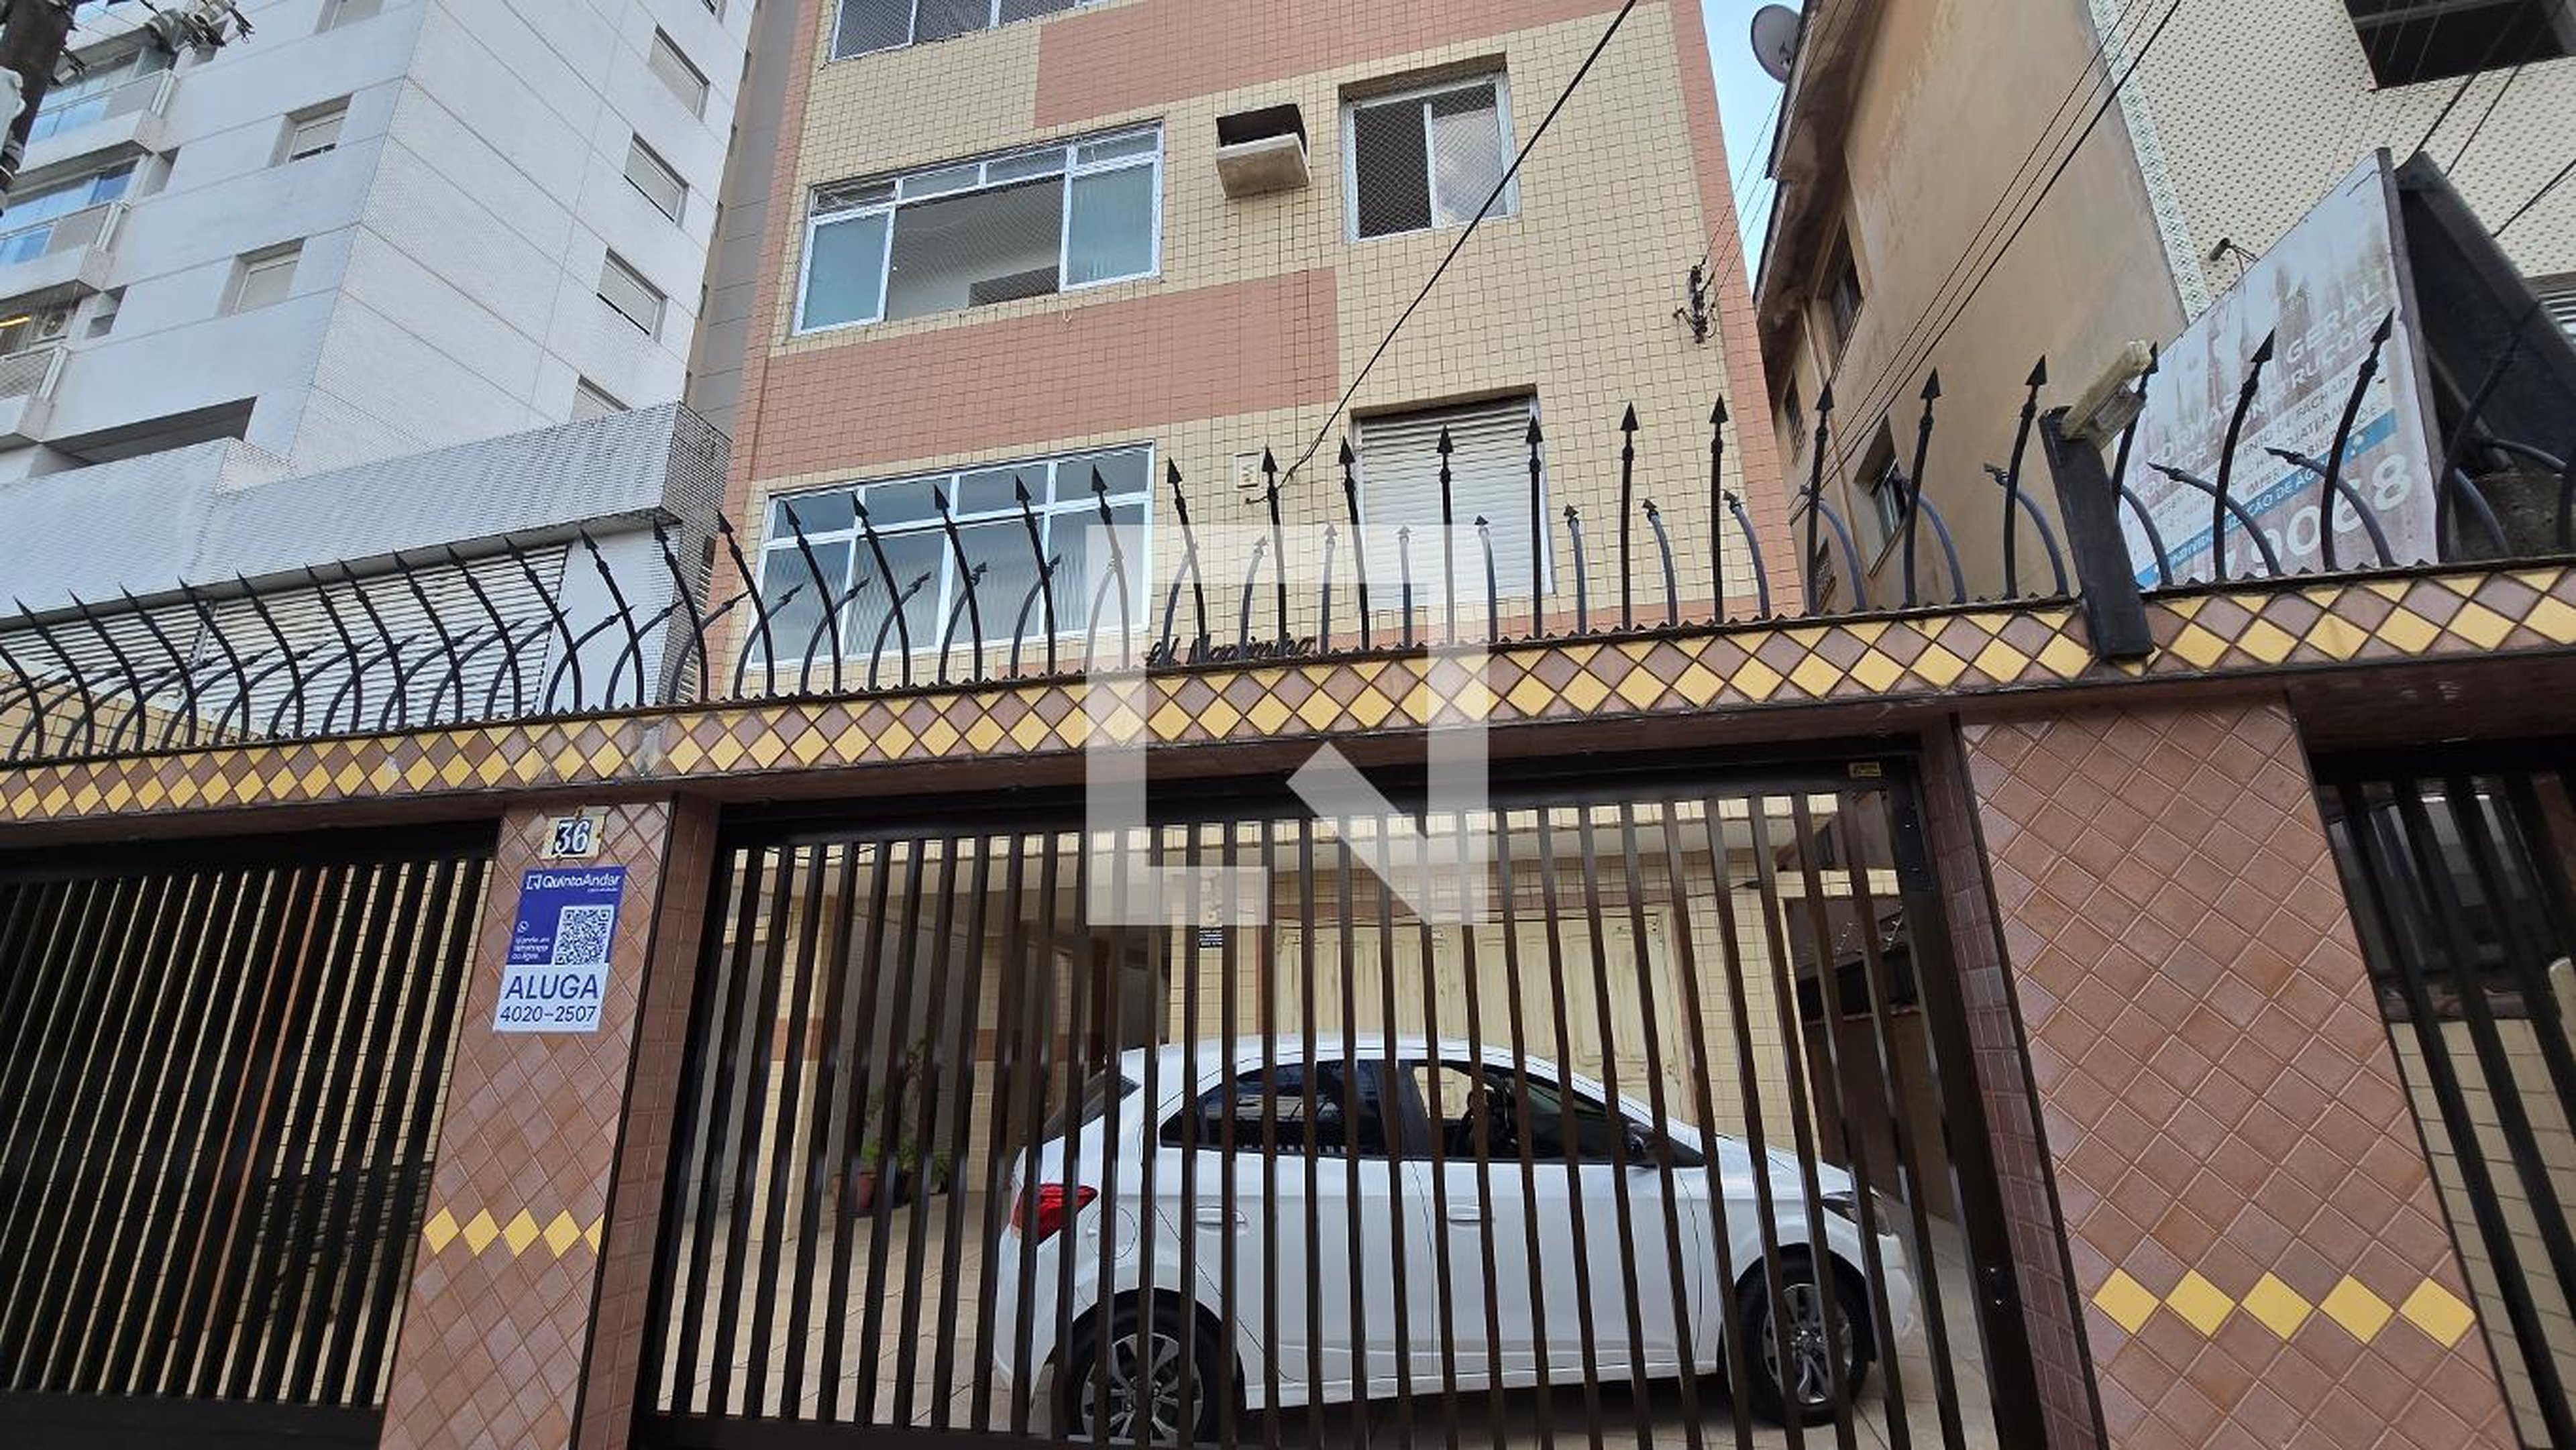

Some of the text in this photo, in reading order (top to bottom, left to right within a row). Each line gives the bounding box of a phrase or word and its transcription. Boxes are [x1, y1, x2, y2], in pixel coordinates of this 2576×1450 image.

[2286, 280, 2381, 364] GERAL
[2275, 480, 2292, 500] DE
[554, 820, 590, 853] 36
[542, 873, 621, 889] QuintoAndar
[504, 974, 598, 1000] ALUGA
[500, 1006, 597, 1023] 4020-2507
